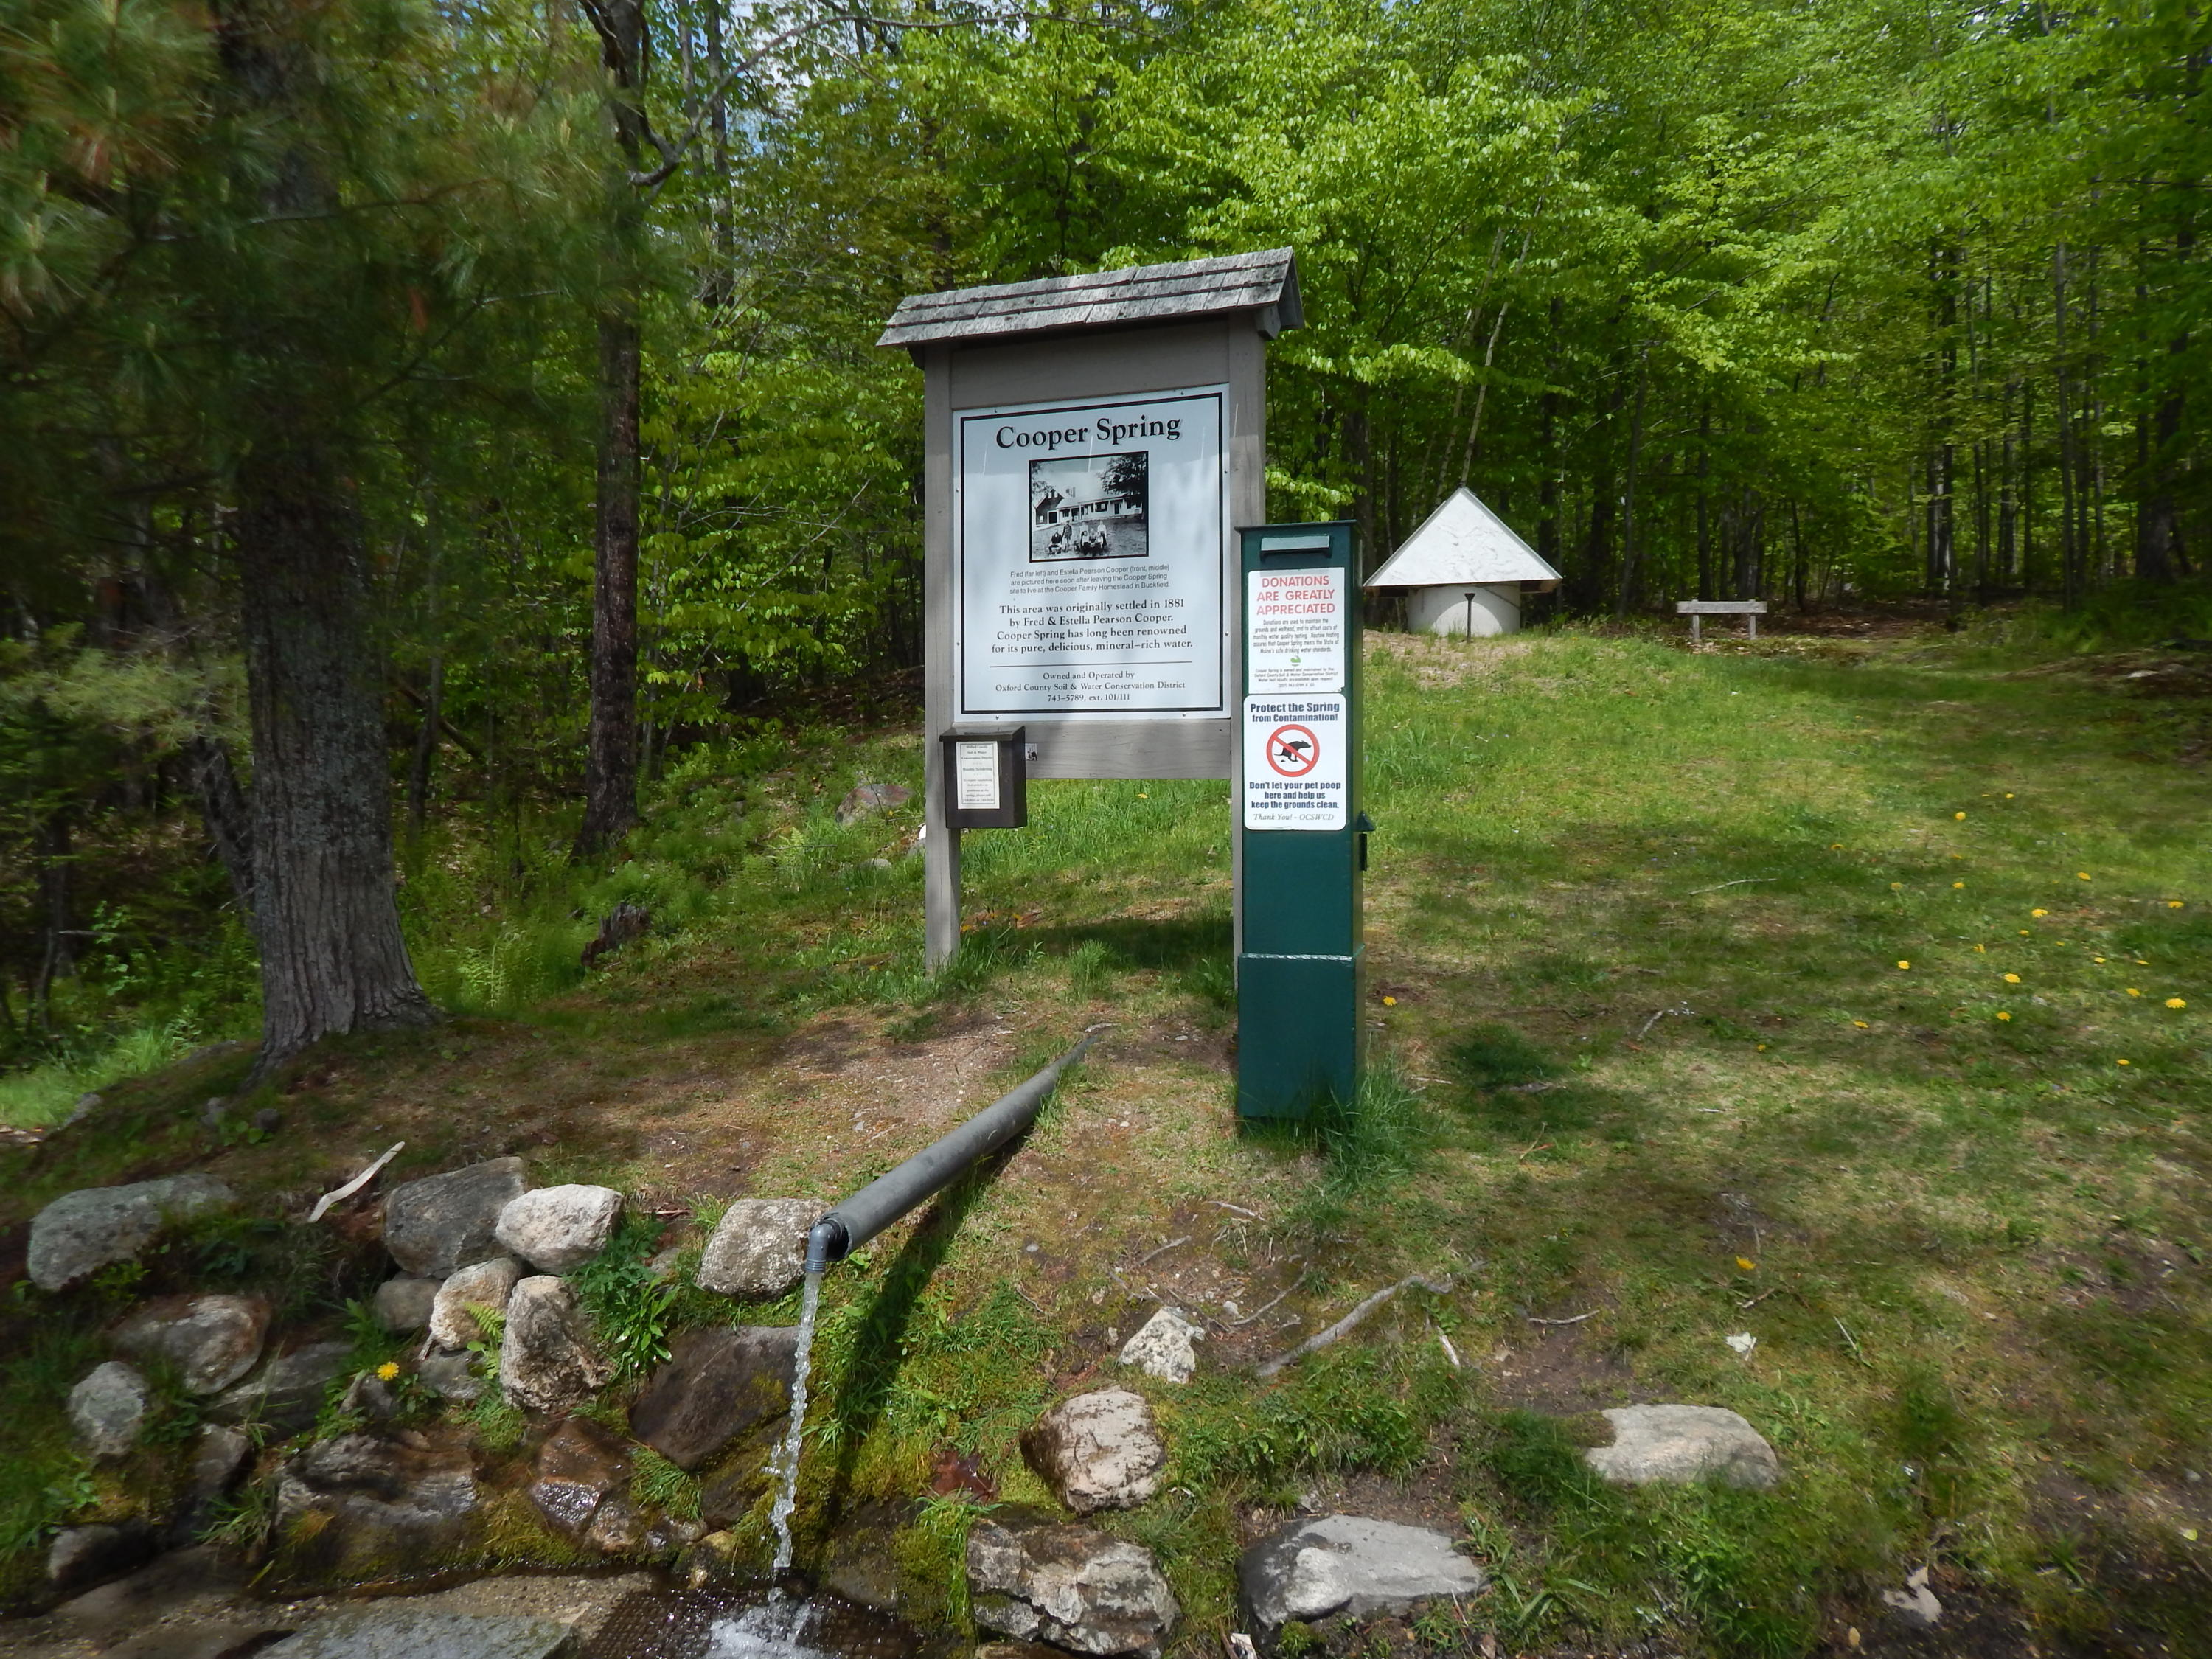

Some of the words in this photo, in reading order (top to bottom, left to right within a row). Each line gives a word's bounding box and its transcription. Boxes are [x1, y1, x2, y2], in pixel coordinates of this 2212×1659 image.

[996, 426, 1088, 450] Cooper
[1097, 415, 1180, 445] Spring
[1262, 576, 1329, 588] DONATIONS
[1257, 591, 1279, 601] ARE
[1285, 589, 1335, 600] GREATLY
[999, 605, 1020, 614] This
[1066, 601, 1112, 613] originally
[1116, 600, 1147, 610] settled
[1151, 600, 1160, 608] in
[1165, 599, 1184, 608] 1881
[1257, 603, 1335, 615] APPRECIATED
[1010, 618, 1020, 628] by
[1024, 617, 1044, 626] Fred
[1048, 617, 1056, 625] &
[1060, 615, 1090, 625] Estella
[1094, 615, 1132, 624] Pearson
[1135, 613, 1173, 624] Cooper.
[997, 631, 1031, 641] Cooper
[1034, 630, 1065, 640] Spring
[1068, 629, 1083, 637] has
[1087, 628, 1107, 639] long
[1111, 627, 1134, 636] been
[1137, 625, 1186, 635] renowned
[992, 644, 1005, 653] for
[1008, 644, 1018, 652] its
[1021, 646, 1045, 654] pure,
[1049, 642, 1093, 651] delicious,
[1089, 671, 1123, 680] Operated
[1126, 670, 1135, 679] by
[1024, 684, 1051, 692] County
[1250, 703, 1286, 712] Protect
[1288, 703, 1304, 712] the
[1307, 702, 1339, 712] Spring
[1274, 714, 1338, 722] Contamination!
[1284, 801, 1315, 809] grounds
